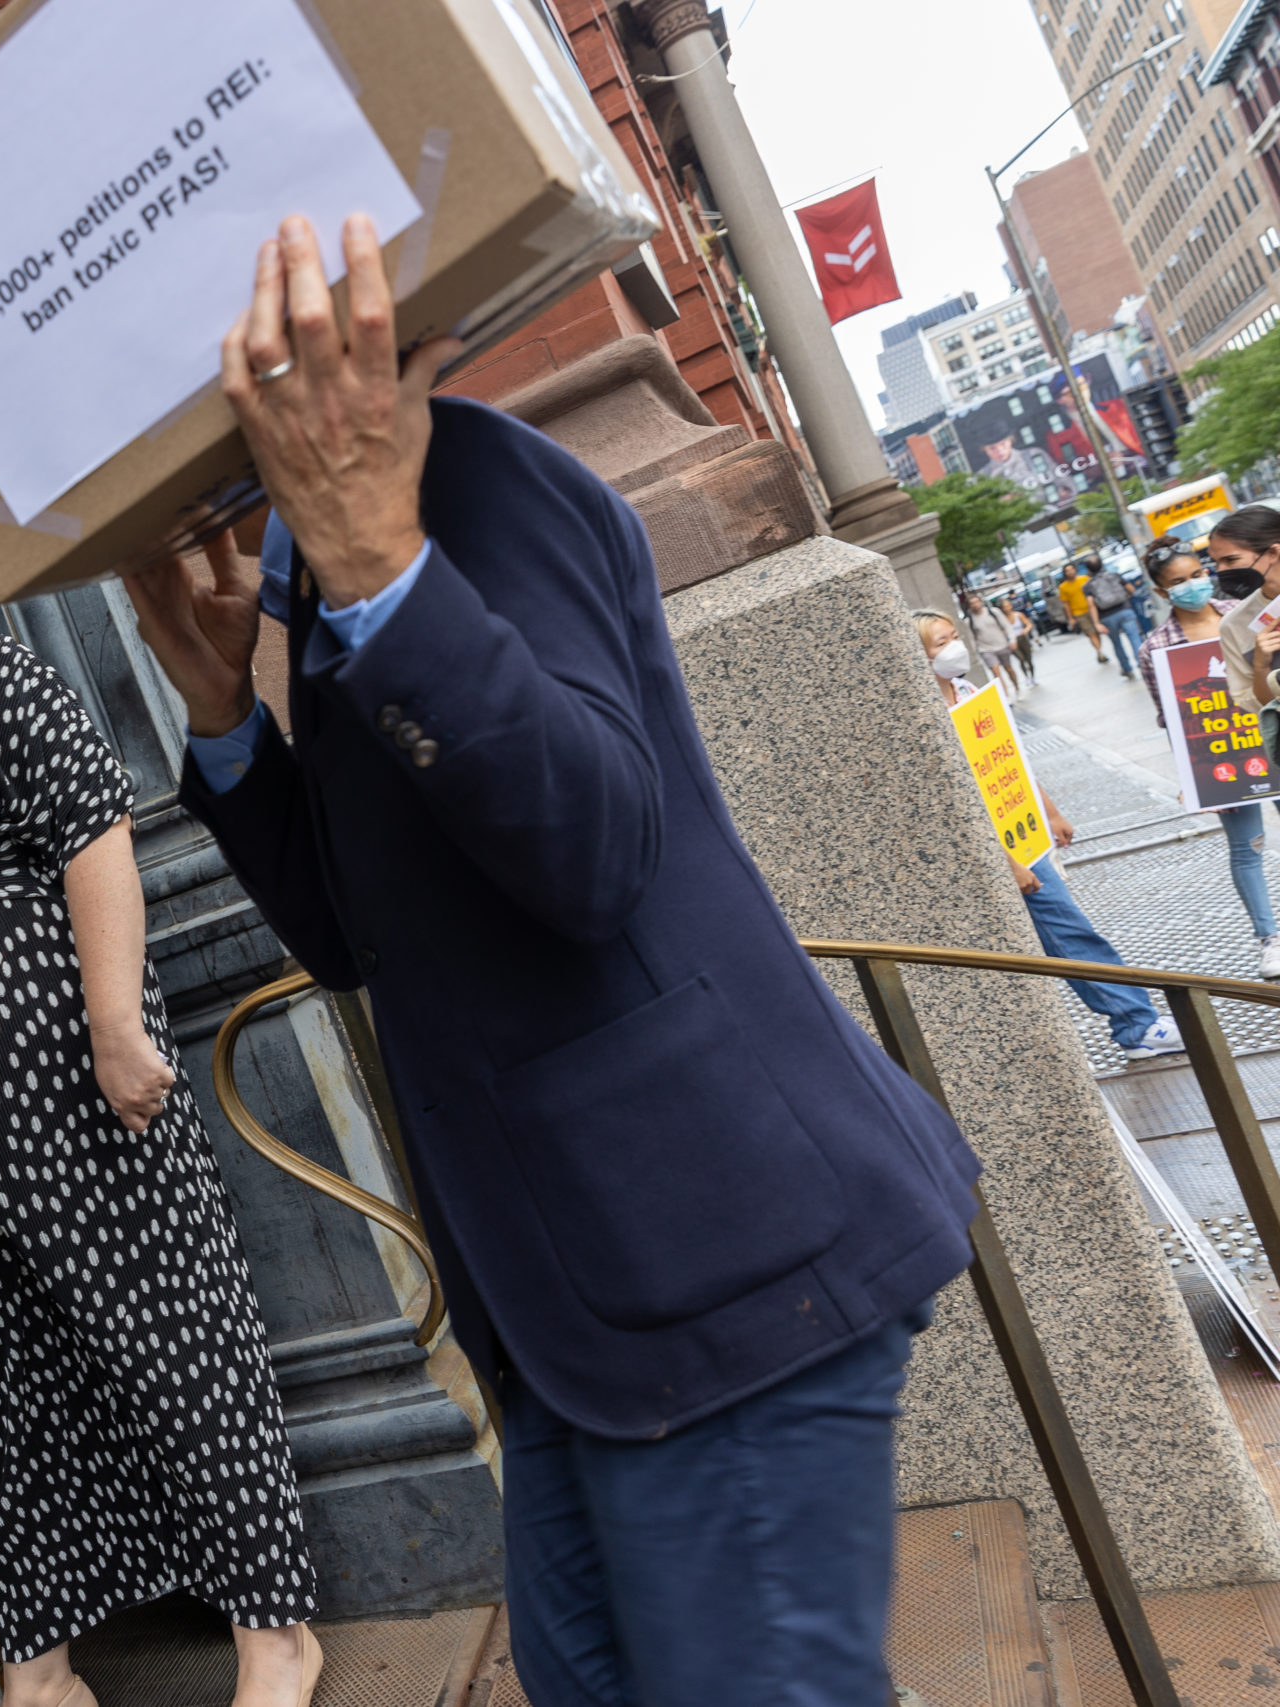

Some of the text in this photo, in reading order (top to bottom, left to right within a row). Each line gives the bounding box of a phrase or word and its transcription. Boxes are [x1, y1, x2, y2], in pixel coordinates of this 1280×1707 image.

[58, 146, 172, 256] petitions
[172, 117, 205, 149] to
[205, 58, 272, 119] REI:
[21, 146, 230, 333] ban toxic PFAS!
[1185, 690, 1228, 714] Tell
[1202, 717, 1229, 733] to
[974, 739, 1015, 779] Tell PFAS
[1209, 740, 1228, 754] a
[986, 766, 1019, 798] to take
[996, 806, 1004, 819] a
